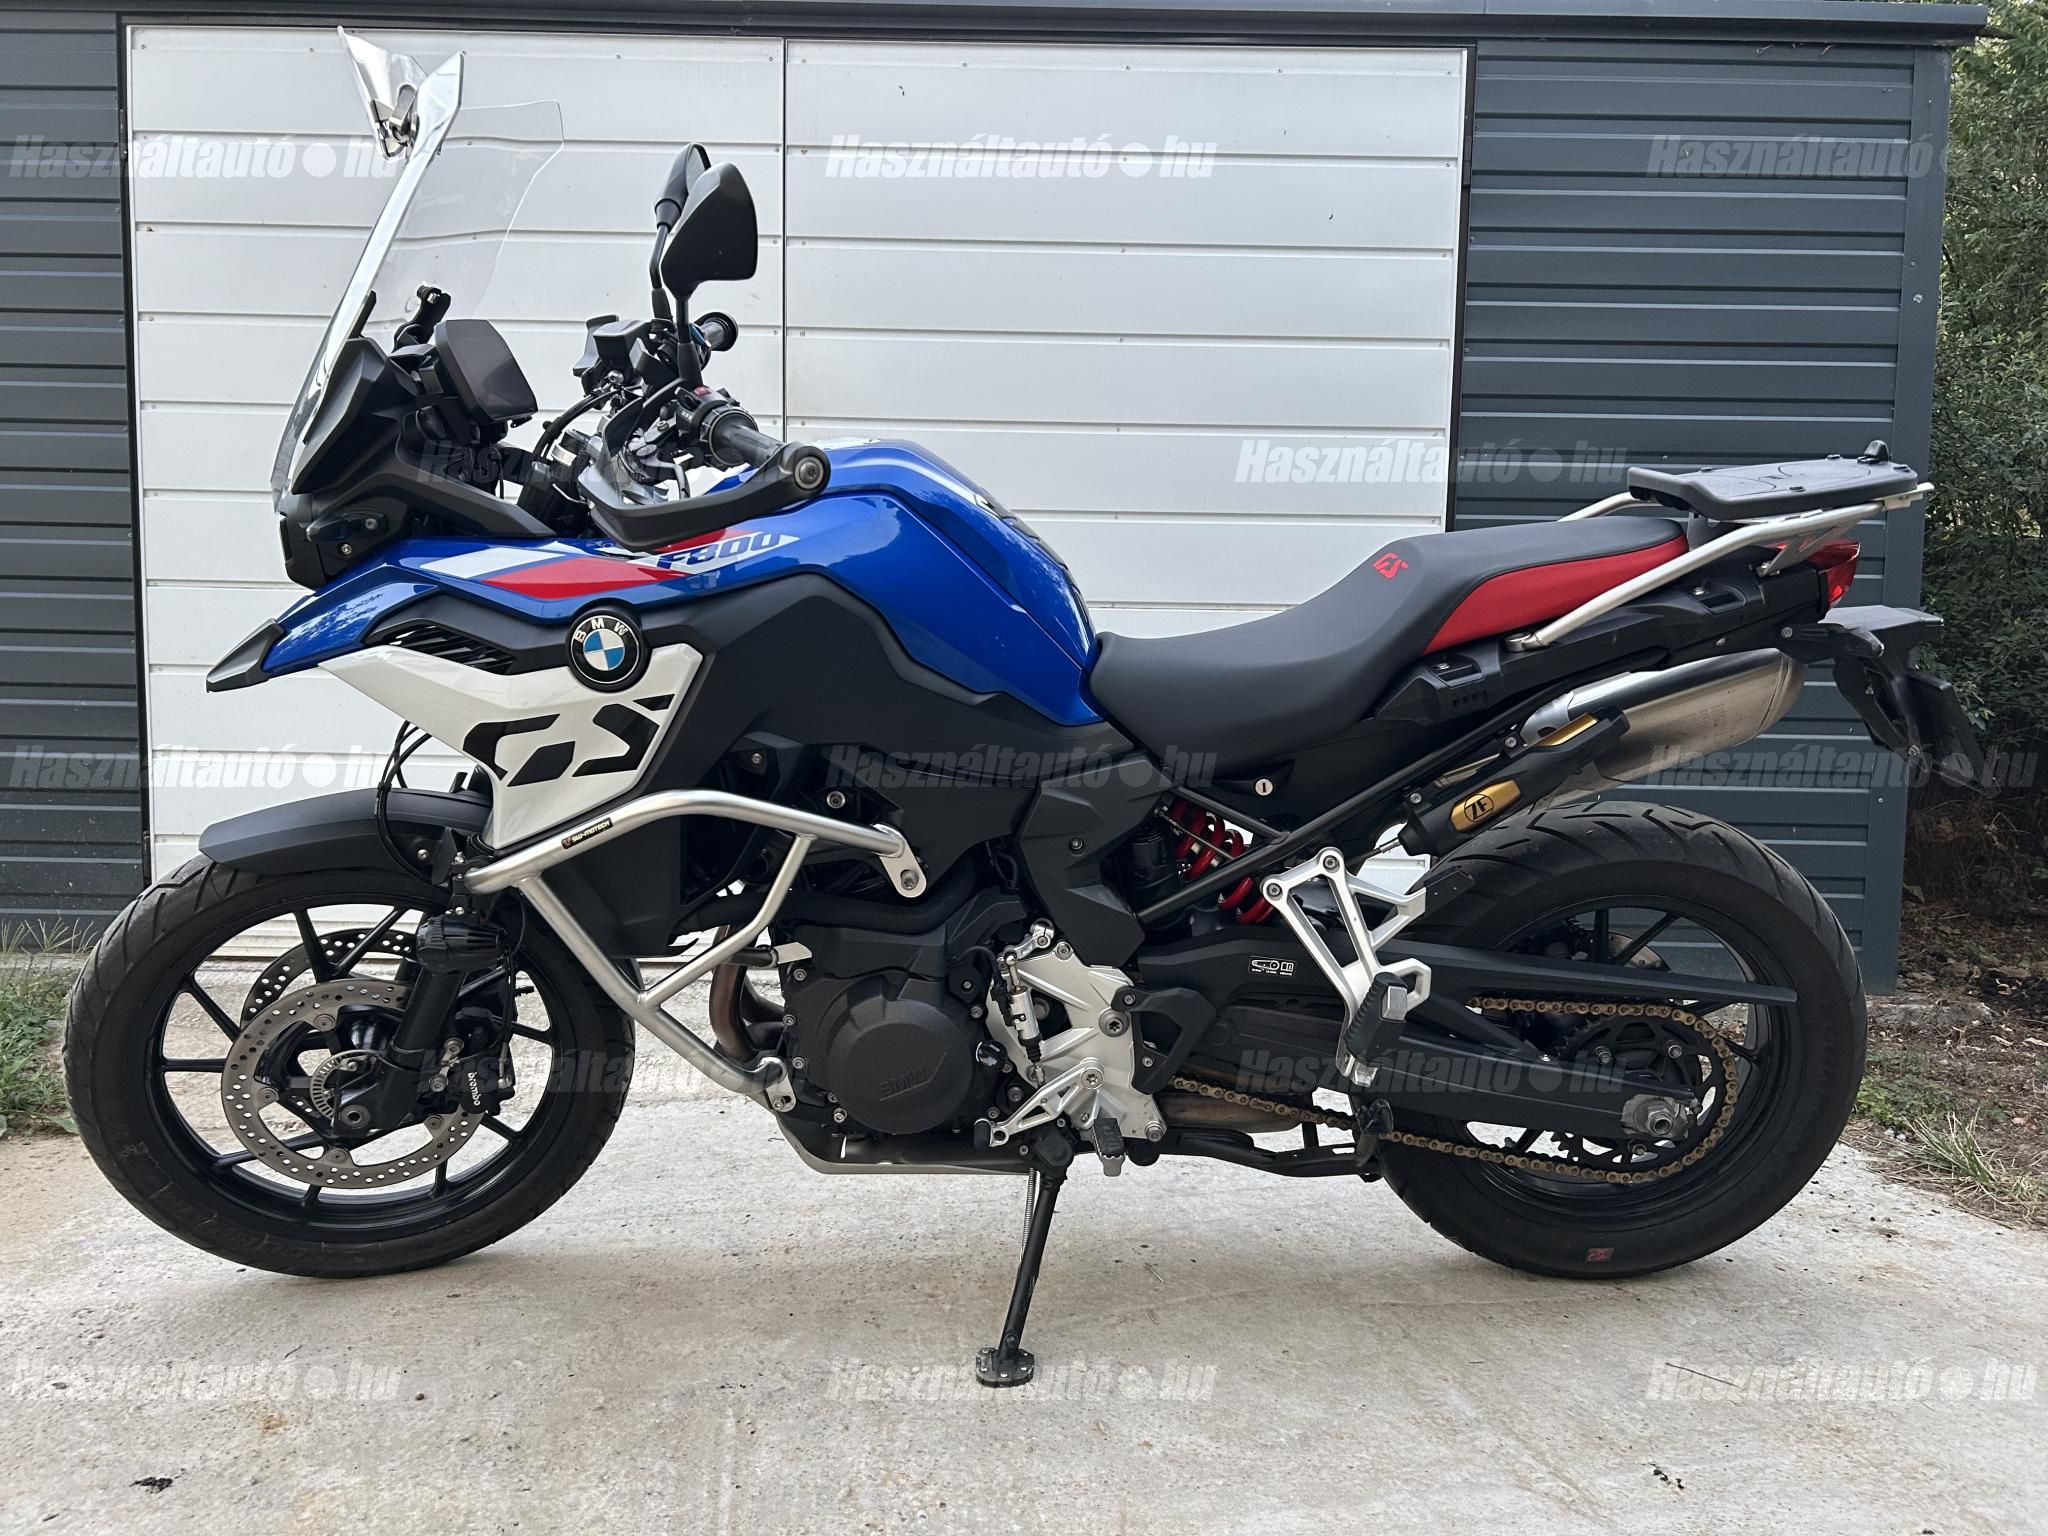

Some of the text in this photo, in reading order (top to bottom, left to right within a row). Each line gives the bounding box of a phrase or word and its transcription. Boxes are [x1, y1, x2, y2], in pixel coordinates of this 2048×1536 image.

[573, 616, 629, 644] BMW
[463, 693, 676, 788] GS
[571, 820, 611, 843] SW-MOTECH
[467, 1071, 482, 1106] brembo
